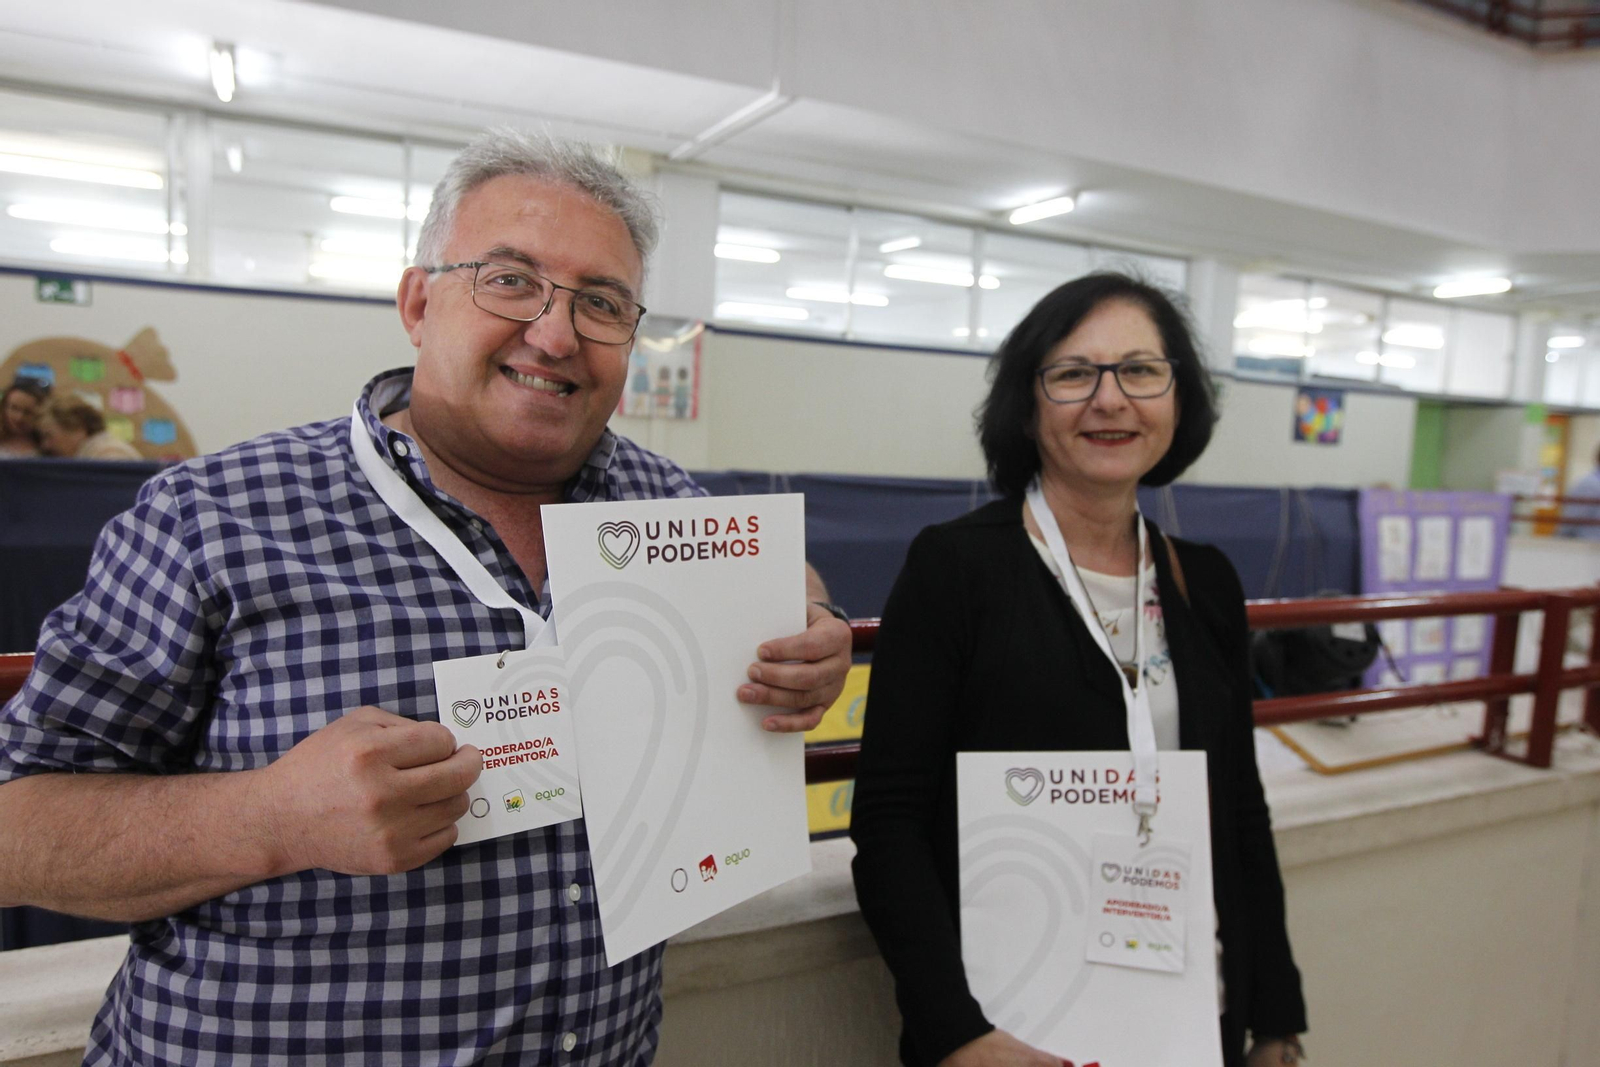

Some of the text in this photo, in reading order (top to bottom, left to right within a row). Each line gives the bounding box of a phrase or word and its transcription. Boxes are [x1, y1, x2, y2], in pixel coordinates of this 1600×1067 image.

[646, 516, 759, 540] UNIDAS
[647, 538, 759, 564] PODEMOS
[484, 688, 558, 709] UNIDAS
[485, 701, 560, 723] PODEMOS
[479, 737, 554, 757] PODERADO/A
[535, 787, 565, 801] equo
[1051, 789, 1161, 804] PODEM
[725, 848, 750, 865] equo
[1124, 866, 1181, 880] UNIDAS
[1123, 876, 1180, 890] PODEMOS
